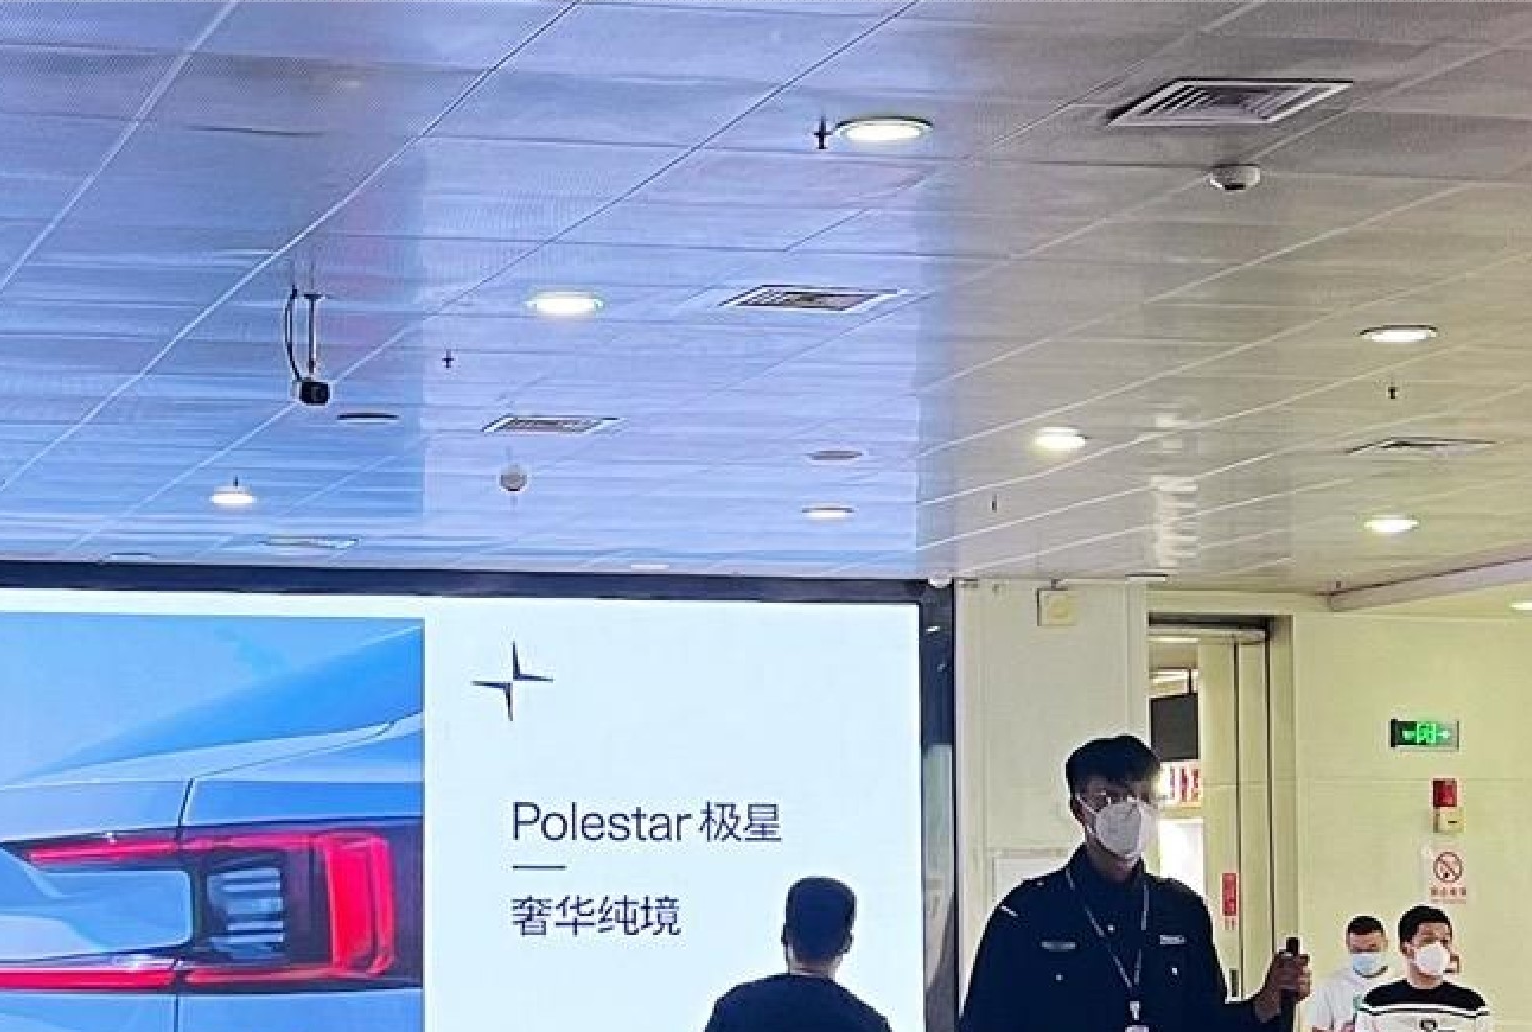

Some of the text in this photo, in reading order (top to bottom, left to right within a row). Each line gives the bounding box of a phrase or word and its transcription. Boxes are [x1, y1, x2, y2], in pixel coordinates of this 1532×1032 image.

[513, 801, 782, 843] Polestar 极星
[512, 894, 682, 936] 奢华纯境
